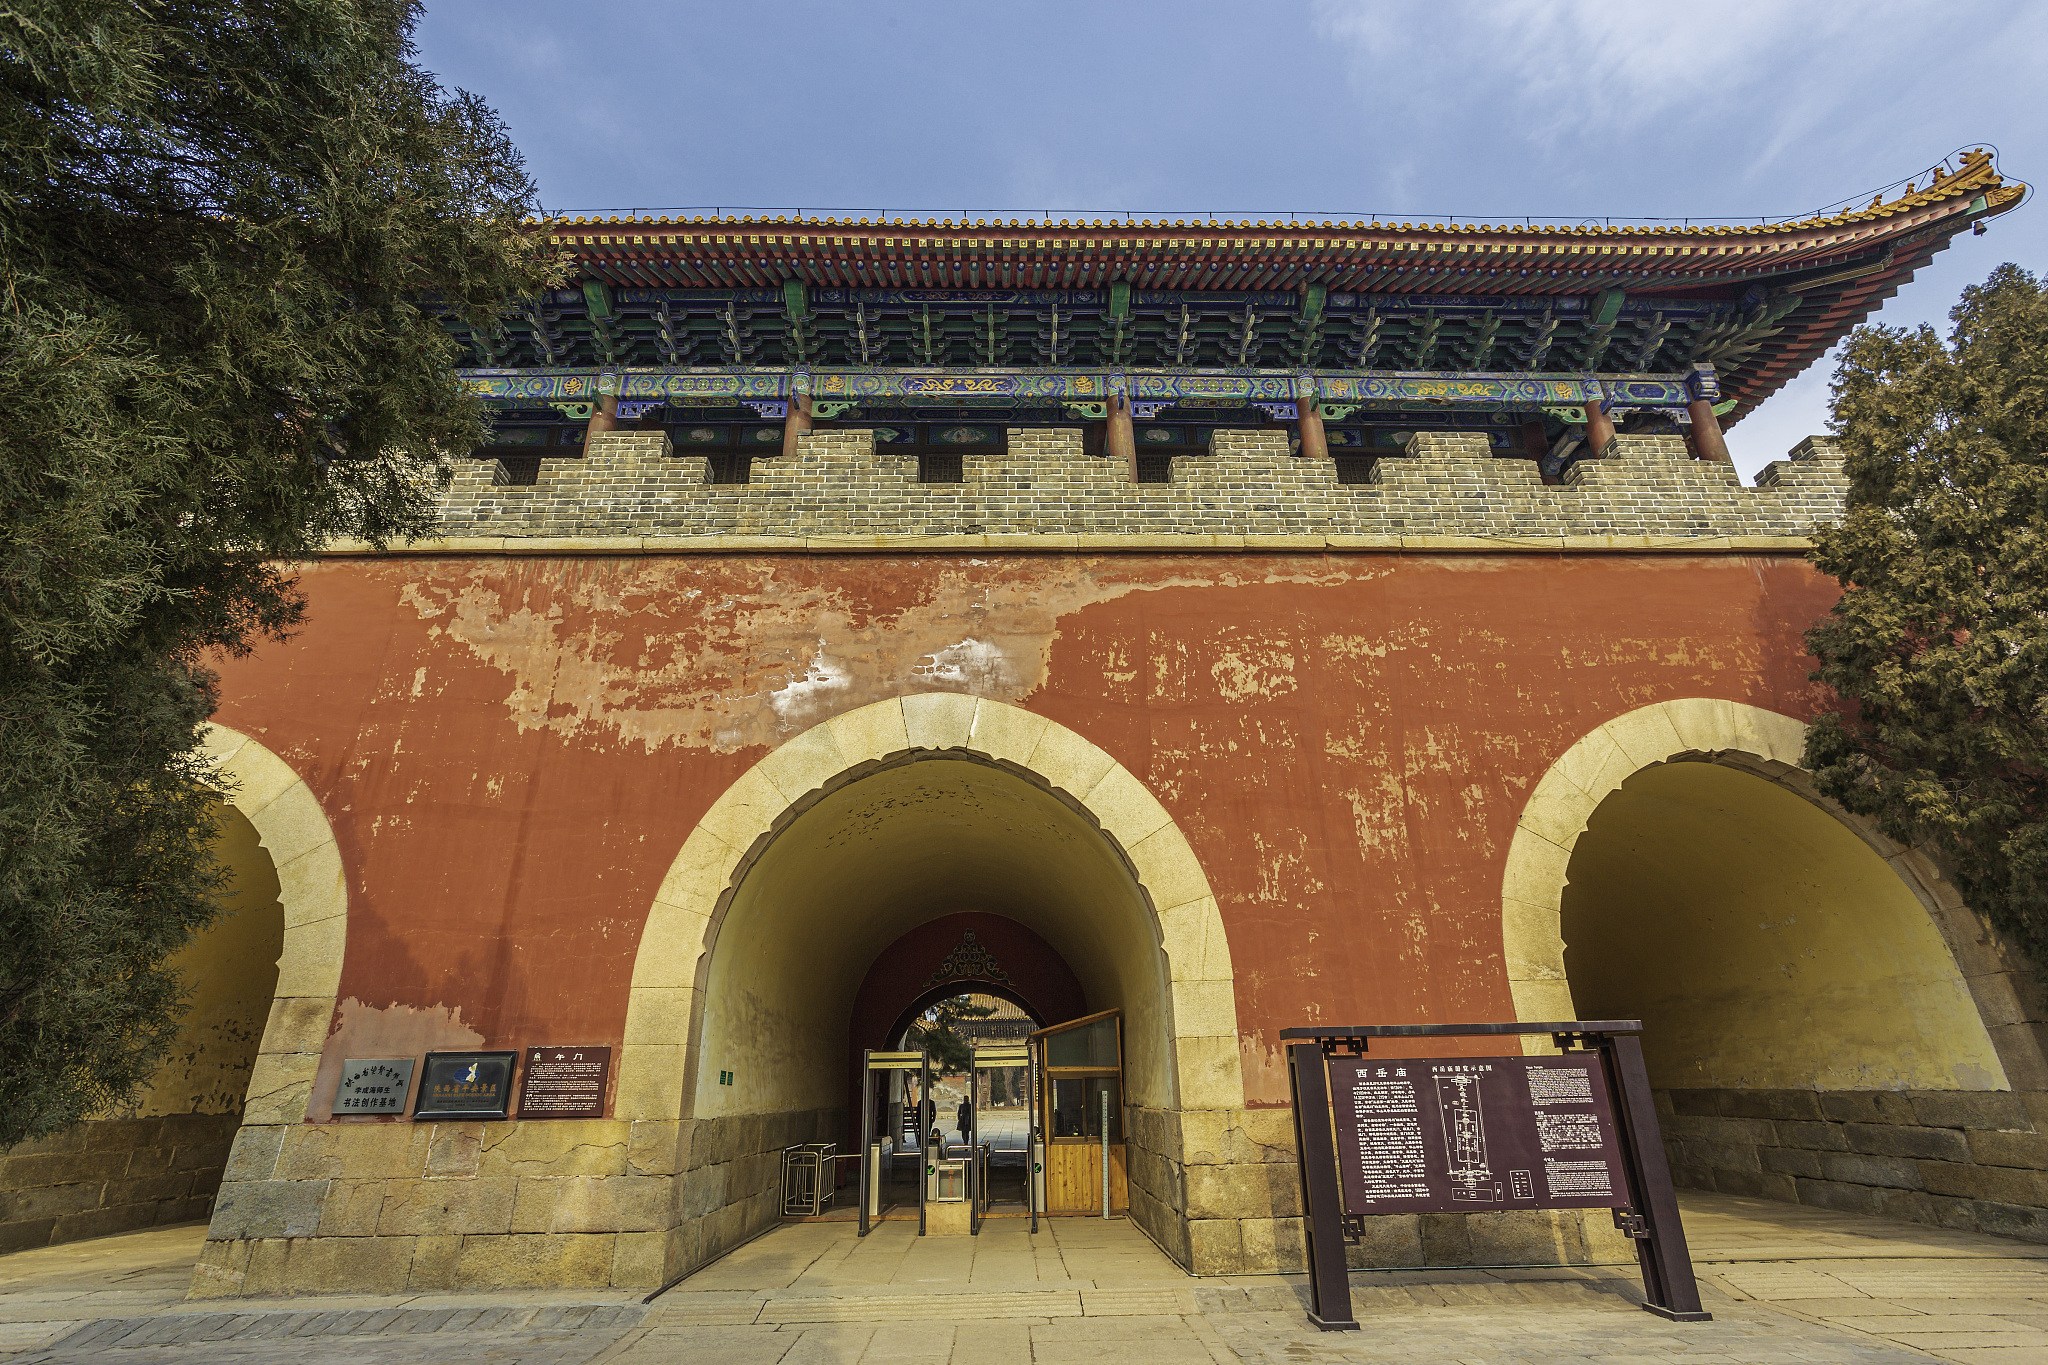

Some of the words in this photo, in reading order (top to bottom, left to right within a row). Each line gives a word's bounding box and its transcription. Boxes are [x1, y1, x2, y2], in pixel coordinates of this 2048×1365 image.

[555, 1053, 583, 1061] 午门
[1355, 1067, 1407, 1078] 西岳庙
[433, 1083, 497, 1093] 陕西省平安景区
[343, 1097, 397, 1108] 书法创作基地
